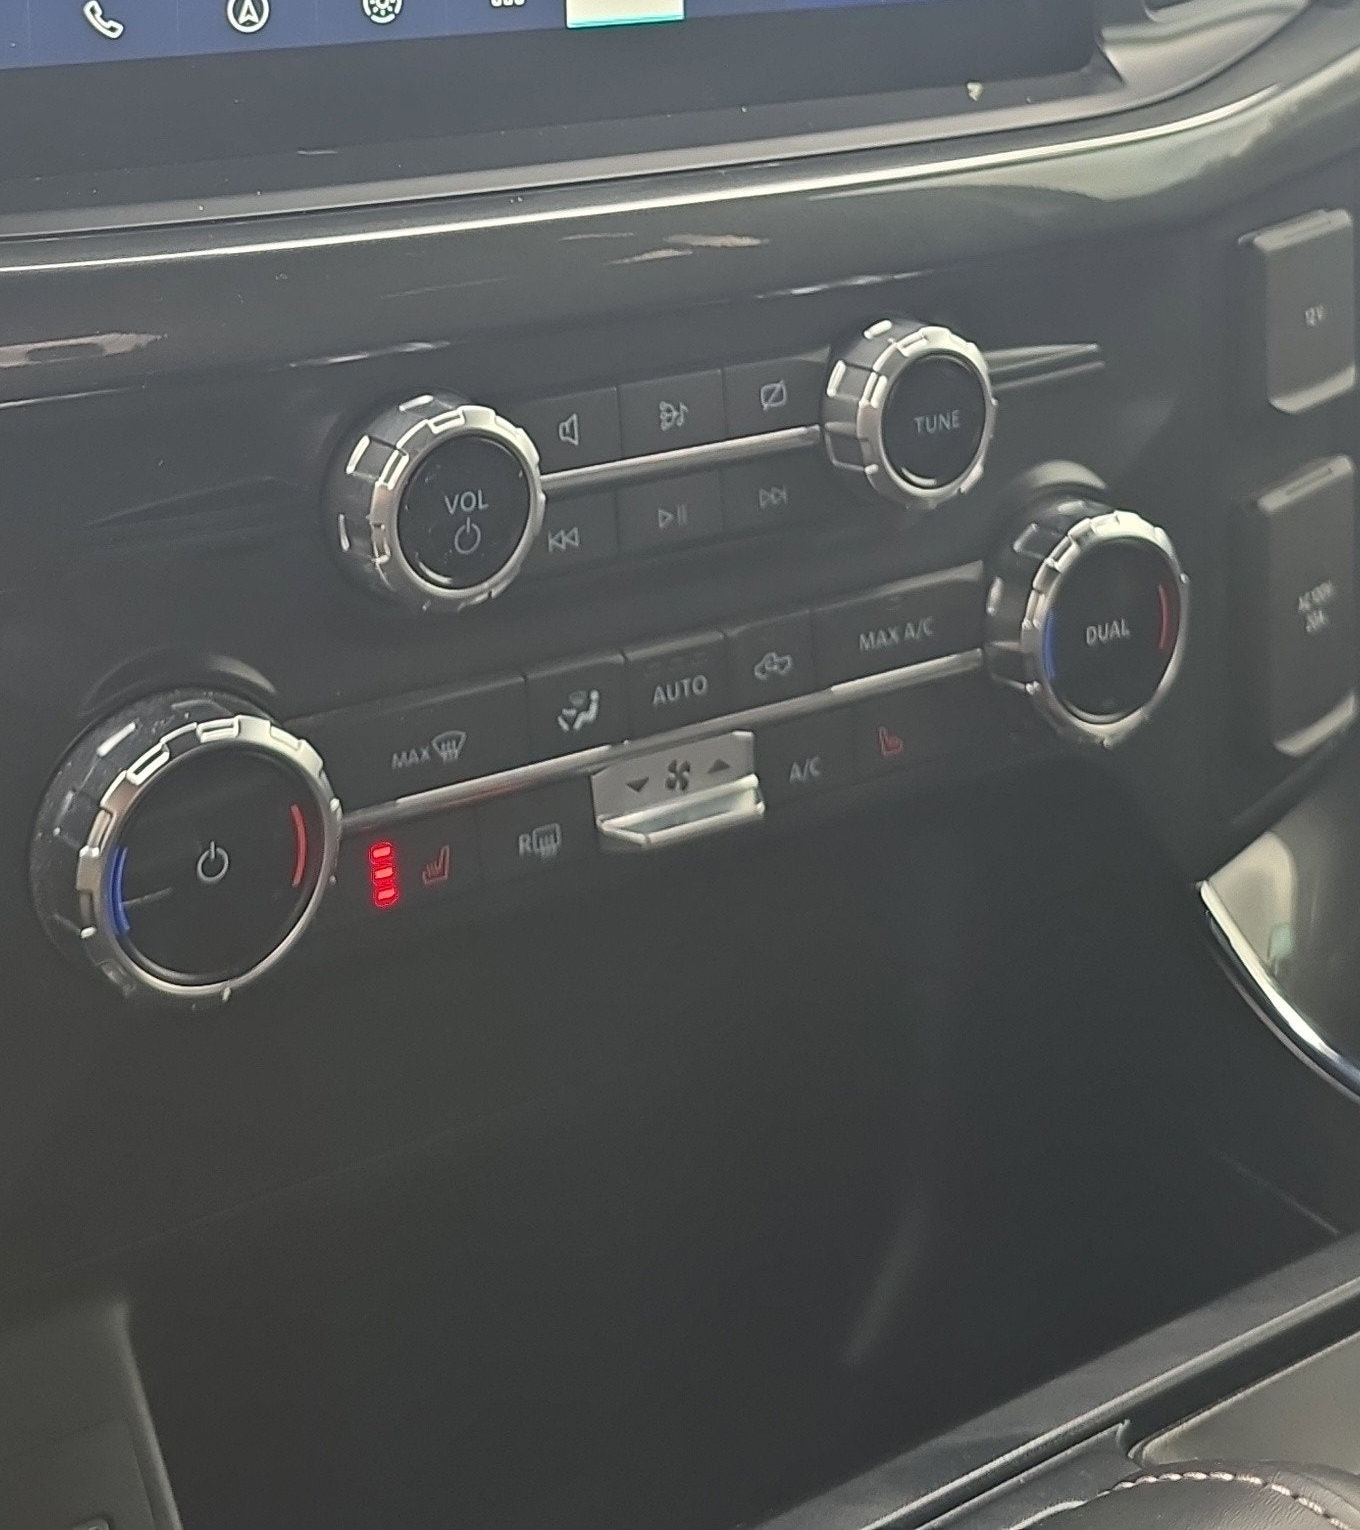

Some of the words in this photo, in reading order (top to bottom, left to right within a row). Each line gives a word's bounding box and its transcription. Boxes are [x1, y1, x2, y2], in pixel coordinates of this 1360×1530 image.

[913, 408, 961, 438] TUNE
[443, 488, 490, 516] VOL
[858, 626, 900, 653] MAX
[903, 615, 937, 642] A/C
[1085, 617, 1132, 648] DUAL
[651, 674, 709, 708] AUTO
[392, 745, 431, 771] MAX
[789, 754, 824, 783] A/C
